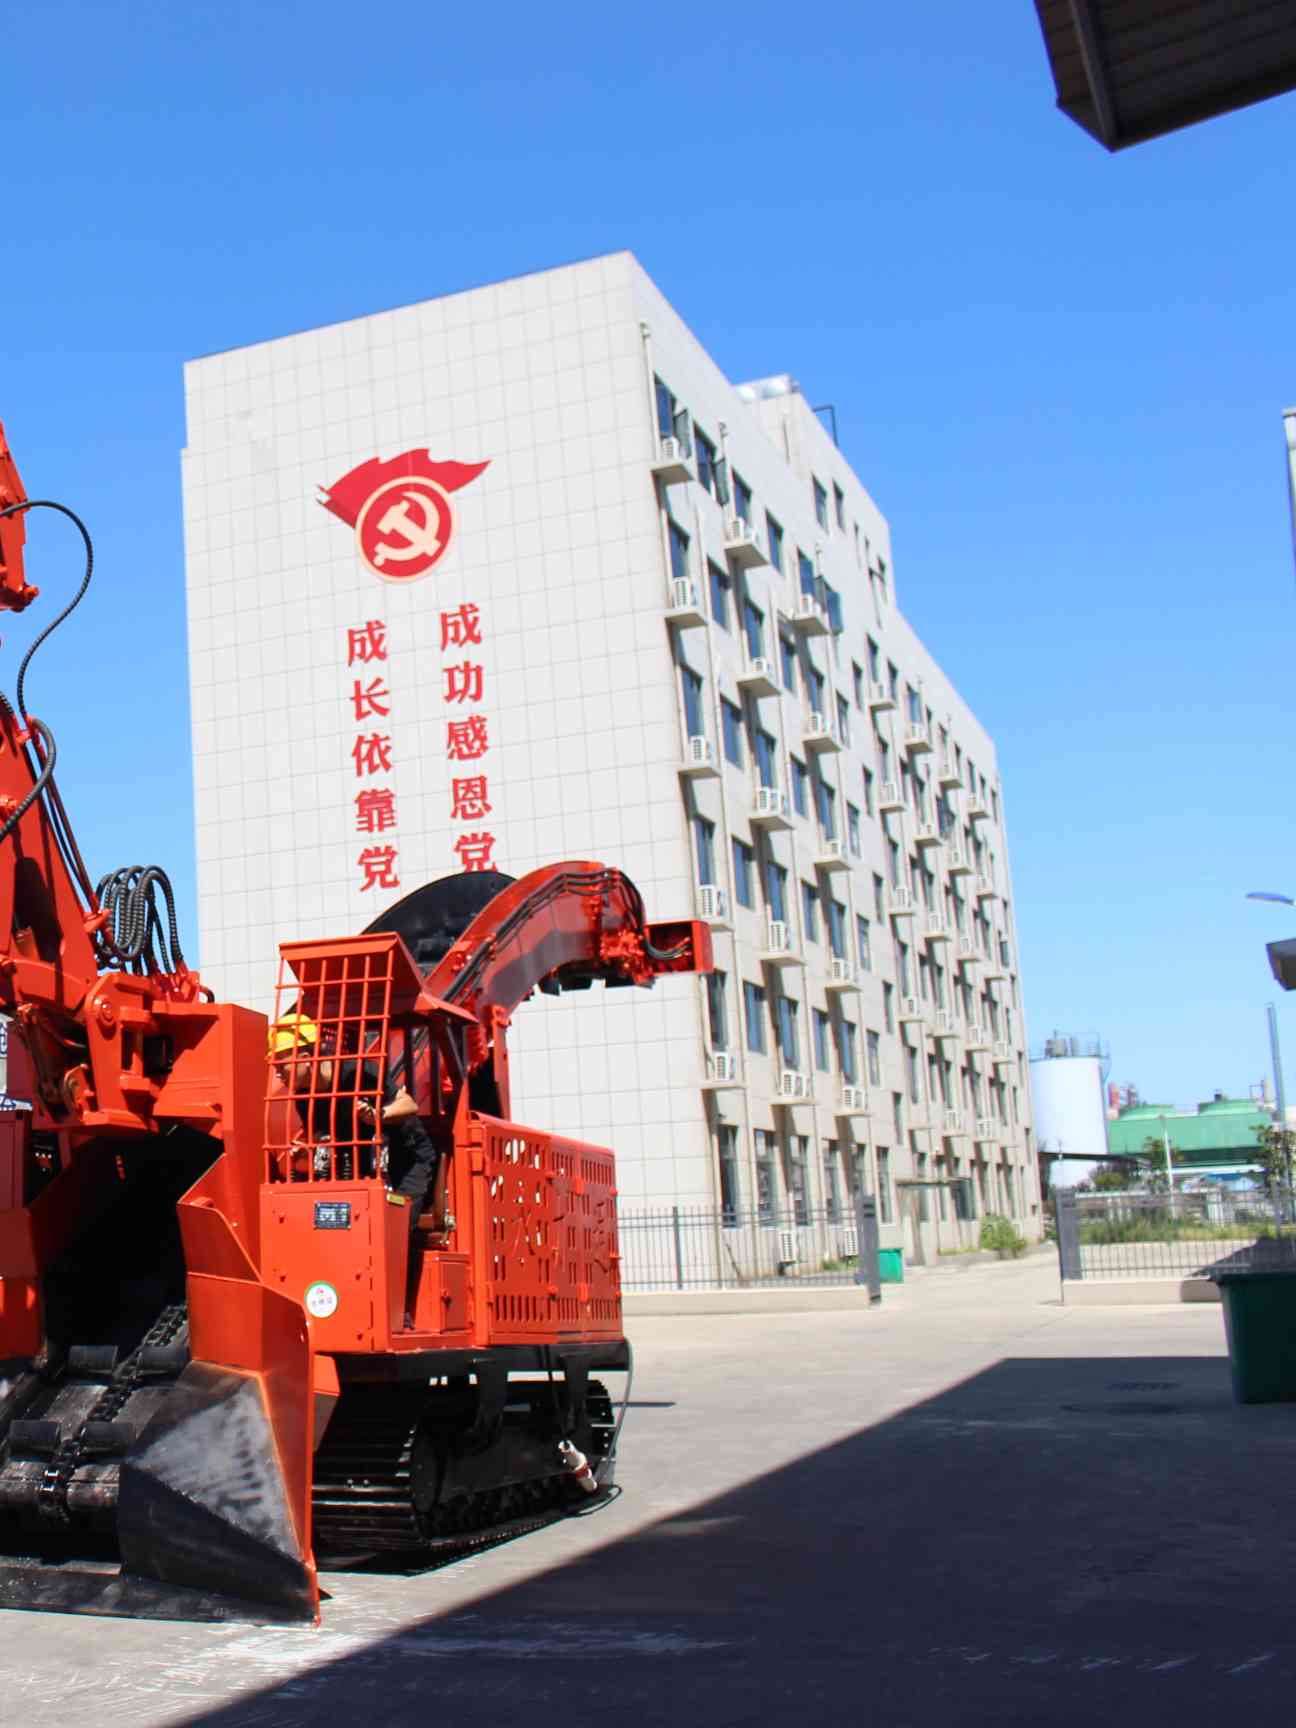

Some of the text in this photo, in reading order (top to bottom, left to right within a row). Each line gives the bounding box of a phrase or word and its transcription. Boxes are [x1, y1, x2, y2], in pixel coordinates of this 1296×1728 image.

[346, 619, 401, 892] 成长依靠党
[440, 602, 498, 873] 成功感恩党
